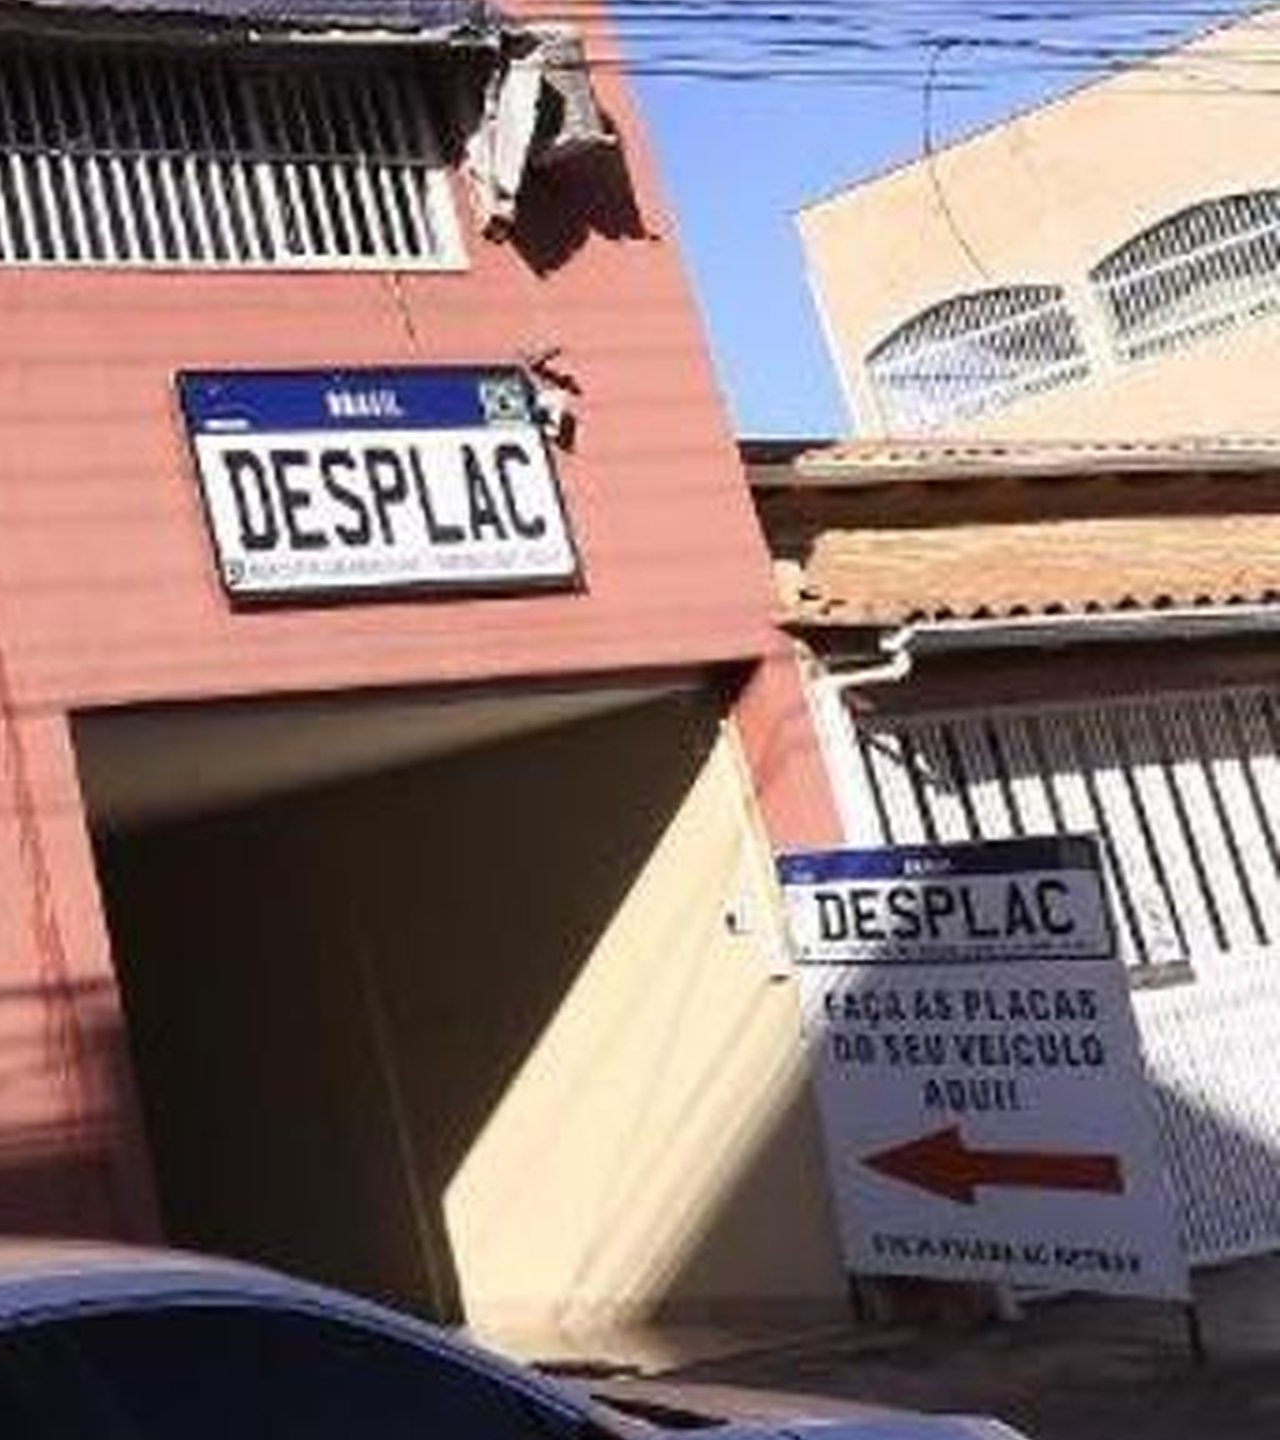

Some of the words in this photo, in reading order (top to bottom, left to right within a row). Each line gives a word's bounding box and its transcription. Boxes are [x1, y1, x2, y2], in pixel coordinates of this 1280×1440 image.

[220, 443, 547, 551] DESPLAC
[814, 880, 1075, 941] DESPLAC
[962, 989, 1097, 1021] PLACAS
[882, 1035, 945, 1065] SEU
